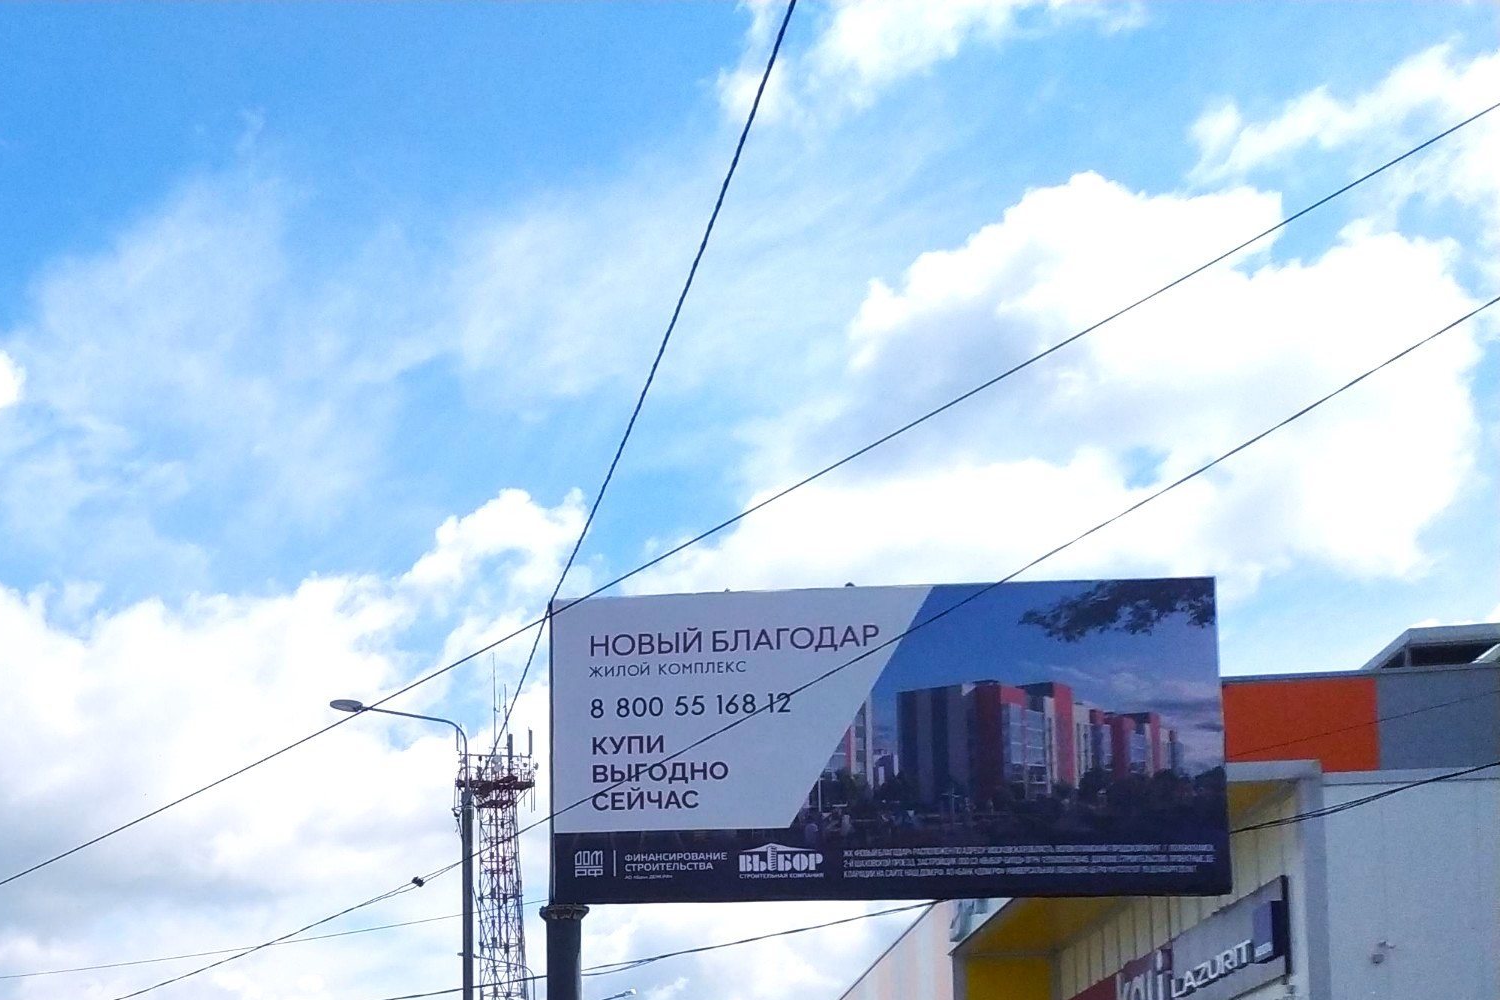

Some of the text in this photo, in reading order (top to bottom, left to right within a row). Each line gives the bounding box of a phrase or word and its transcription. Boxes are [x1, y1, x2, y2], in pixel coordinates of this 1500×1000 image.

[590, 625, 879, 657] НОВЫЙ БЛАГОДАР
[589, 660, 747, 678] ЖИЛОЙ КОМПЛЕКС
[590, 692, 791, 718] 8 800 55 168 12
[592, 734, 664, 755] КУПИ
[592, 761, 729, 784] ВЫГОДНО
[592, 787, 699, 811] СЕЙЧАС
[624, 852, 728, 862] ФИНАНСИРОВАНИЕ
[624, 862, 714, 872] СТРОИТЕЛЬСТВА
[739, 850, 823, 871] ВЫБОР
[1170, 939, 1253, 998] LAZURIT
